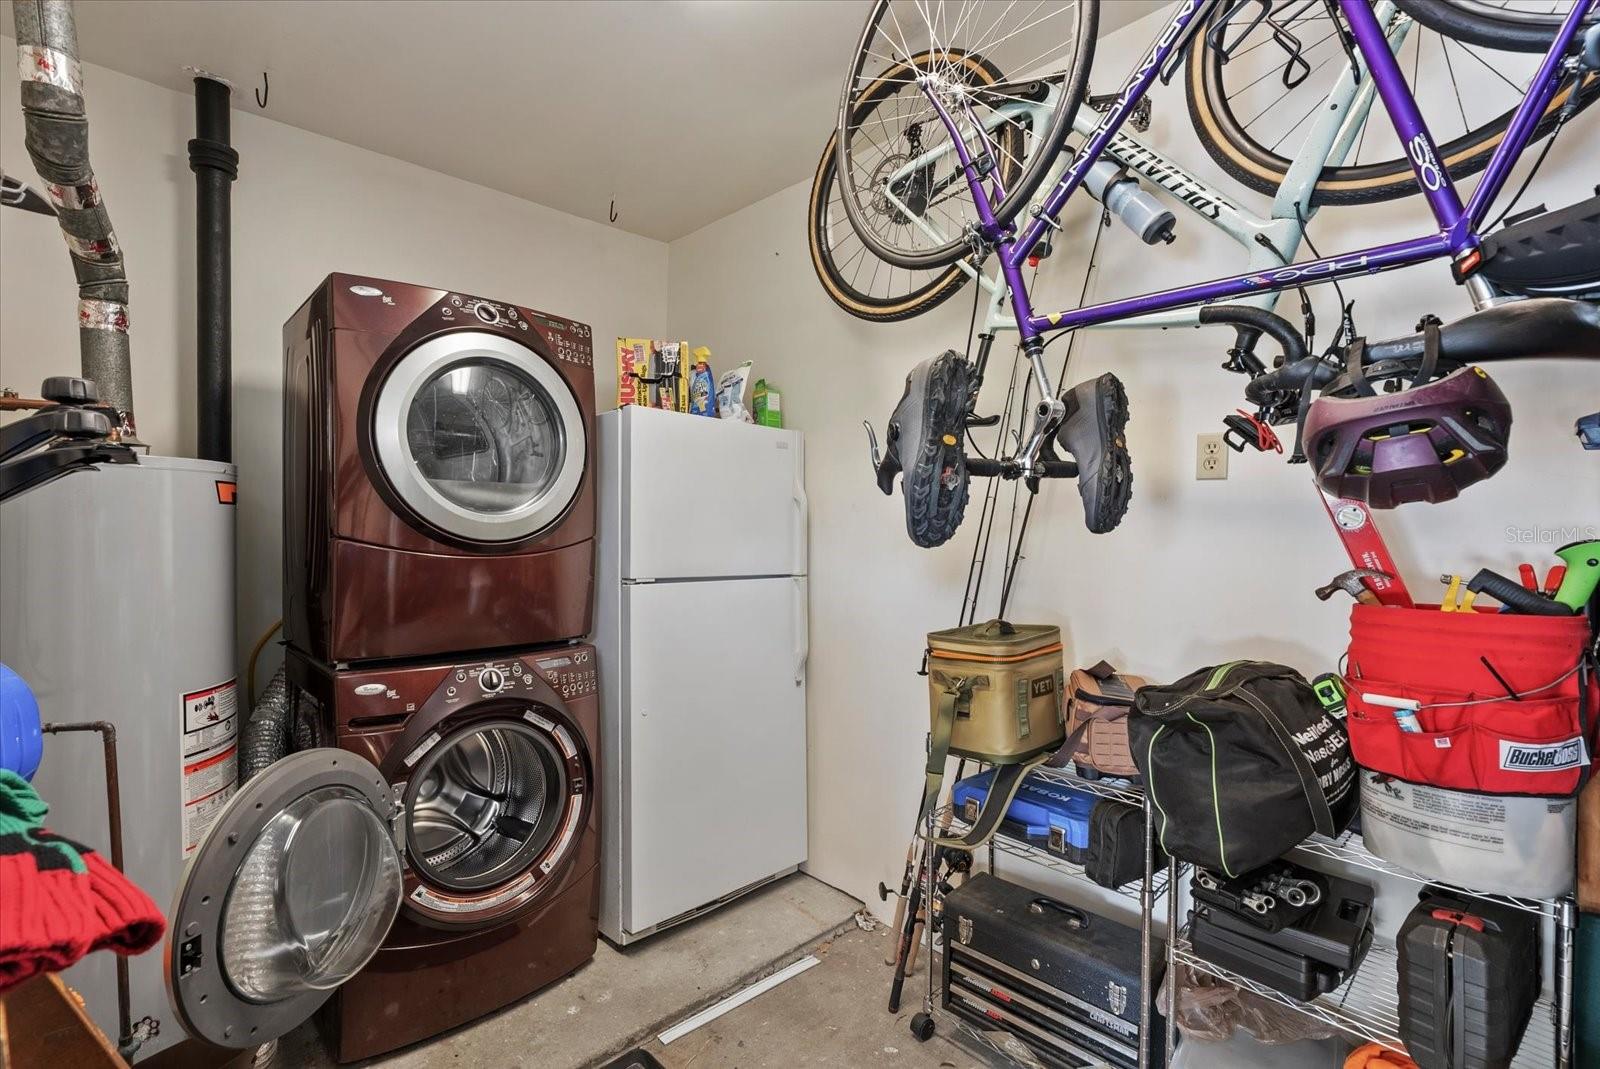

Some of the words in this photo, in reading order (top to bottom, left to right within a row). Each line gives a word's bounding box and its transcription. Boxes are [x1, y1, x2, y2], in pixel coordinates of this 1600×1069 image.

[1058, 0, 1196, 198] ARAMOUNT
[1098, 130, 1237, 221] SPECIALIZE
[1273, 255, 1368, 282] PDG
[1362, 551, 1385, 590] CRAMAN
[1033, 680, 1053, 694] YETI
[1021, 783, 1071, 801] KOBAL
